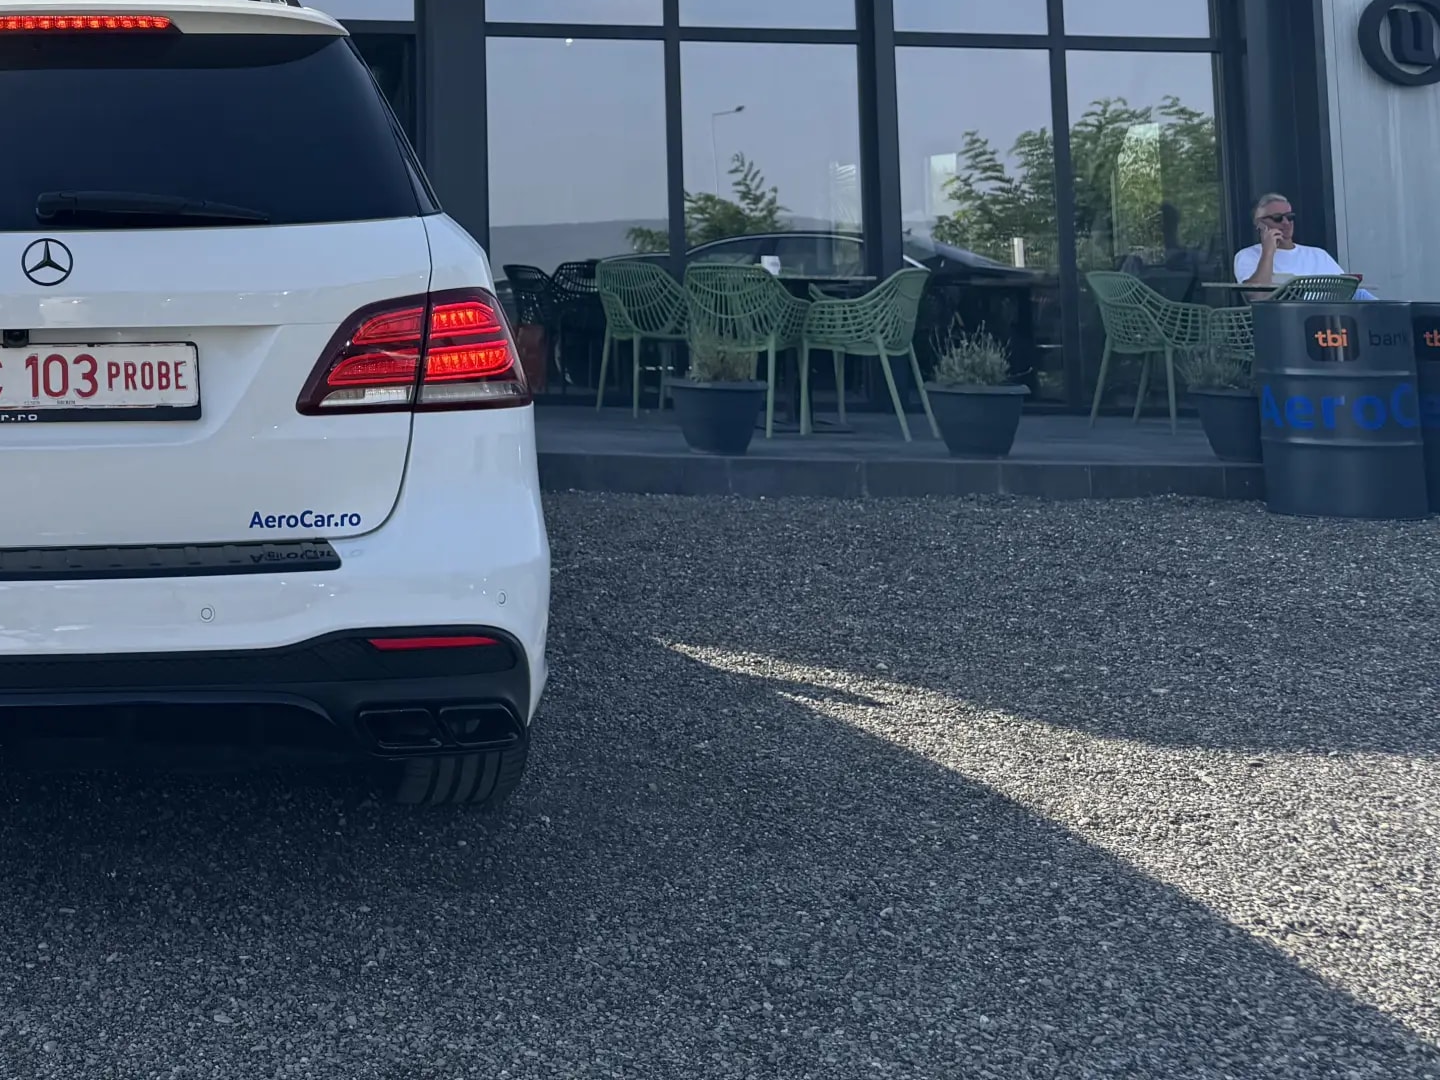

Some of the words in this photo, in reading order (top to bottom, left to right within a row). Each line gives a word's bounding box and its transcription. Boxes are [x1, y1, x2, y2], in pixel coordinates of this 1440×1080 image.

[1315, 329, 1348, 347] tbi
[25, 353, 99, 399] 103
[107, 360, 188, 391] PROBE
[249, 510, 362, 528] AeroCar.ro
